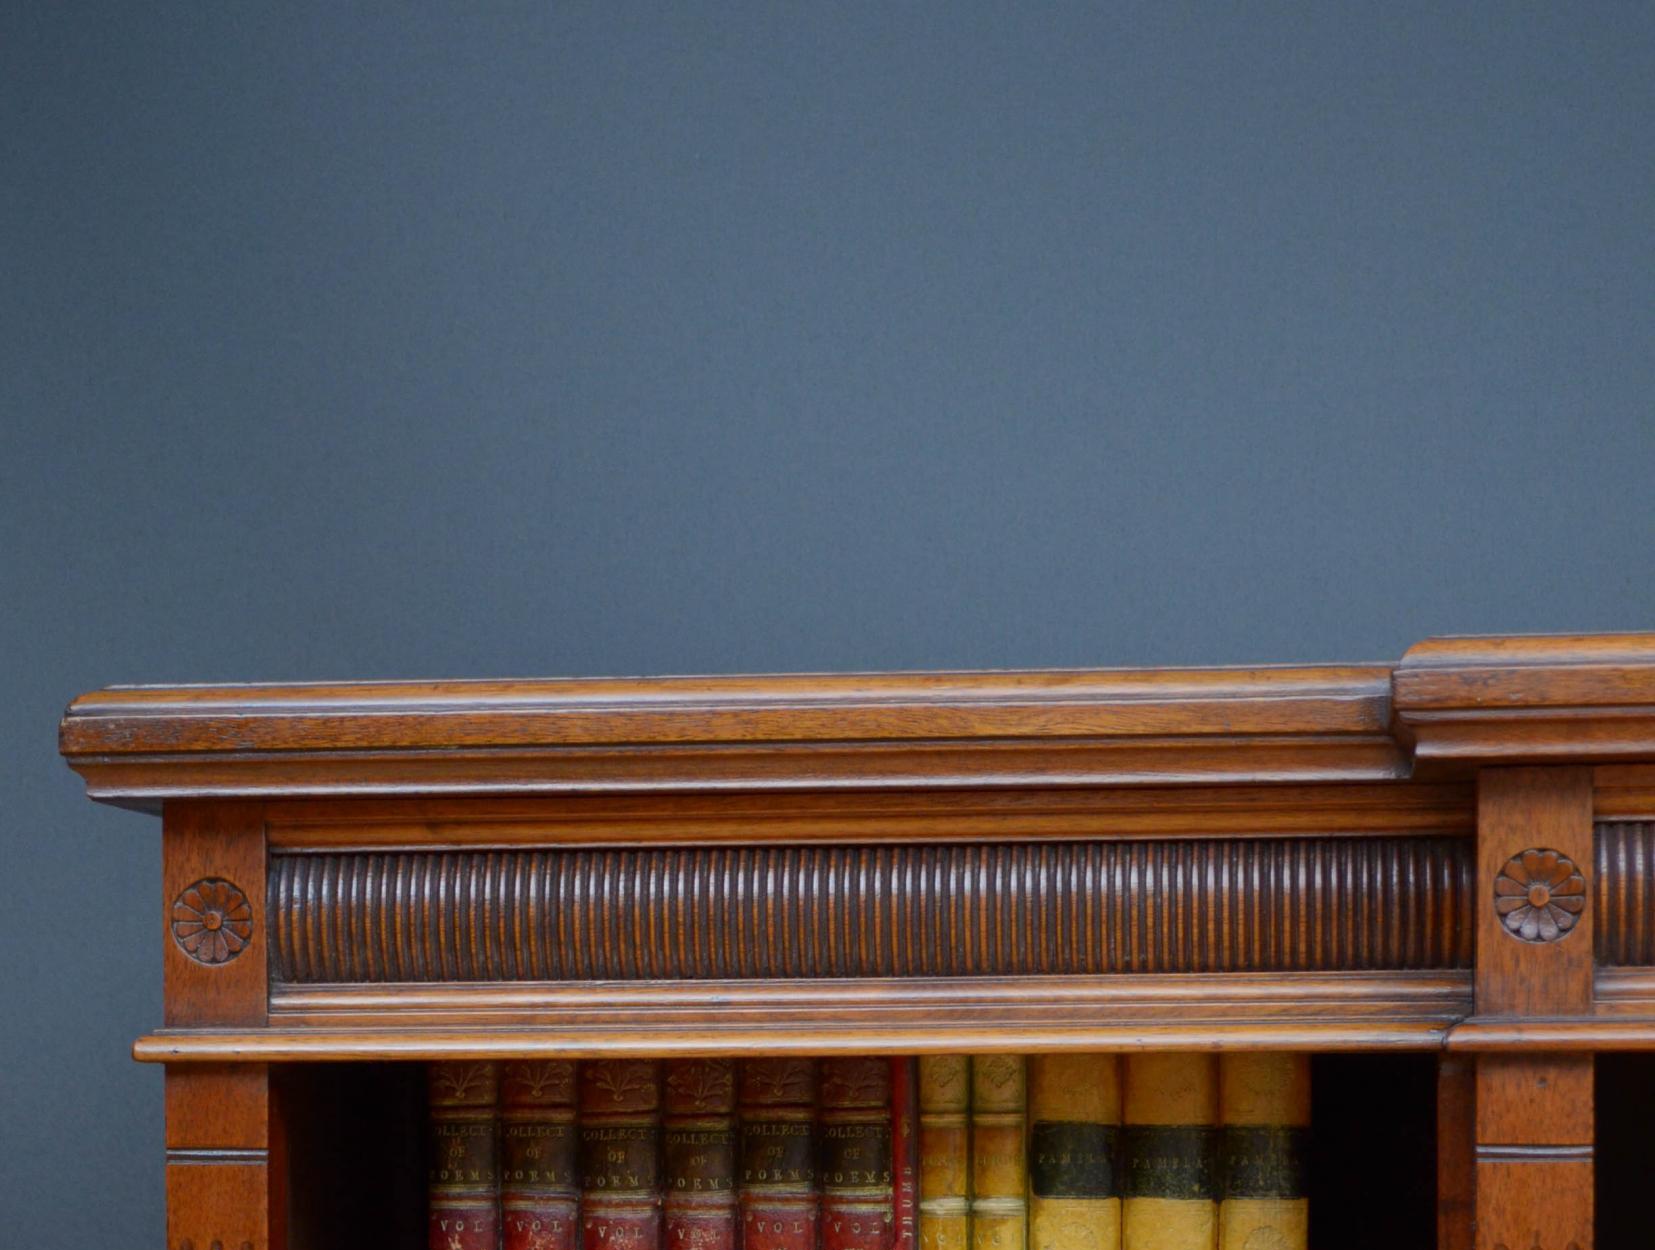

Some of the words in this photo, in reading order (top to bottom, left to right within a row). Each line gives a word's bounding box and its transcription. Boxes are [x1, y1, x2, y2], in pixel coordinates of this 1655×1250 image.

[744, 1168, 814, 1181] POEMS
[901, 1166, 913, 1240] THUMB
[440, 1220, 483, 1232] VOL
[516, 1220, 563, 1233] VOL
[757, 1221, 804, 1234] VOL
[834, 1221, 880, 1235] VOL
[598, 1226, 643, 1240] VOL
[677, 1228, 721, 1241] VOL
